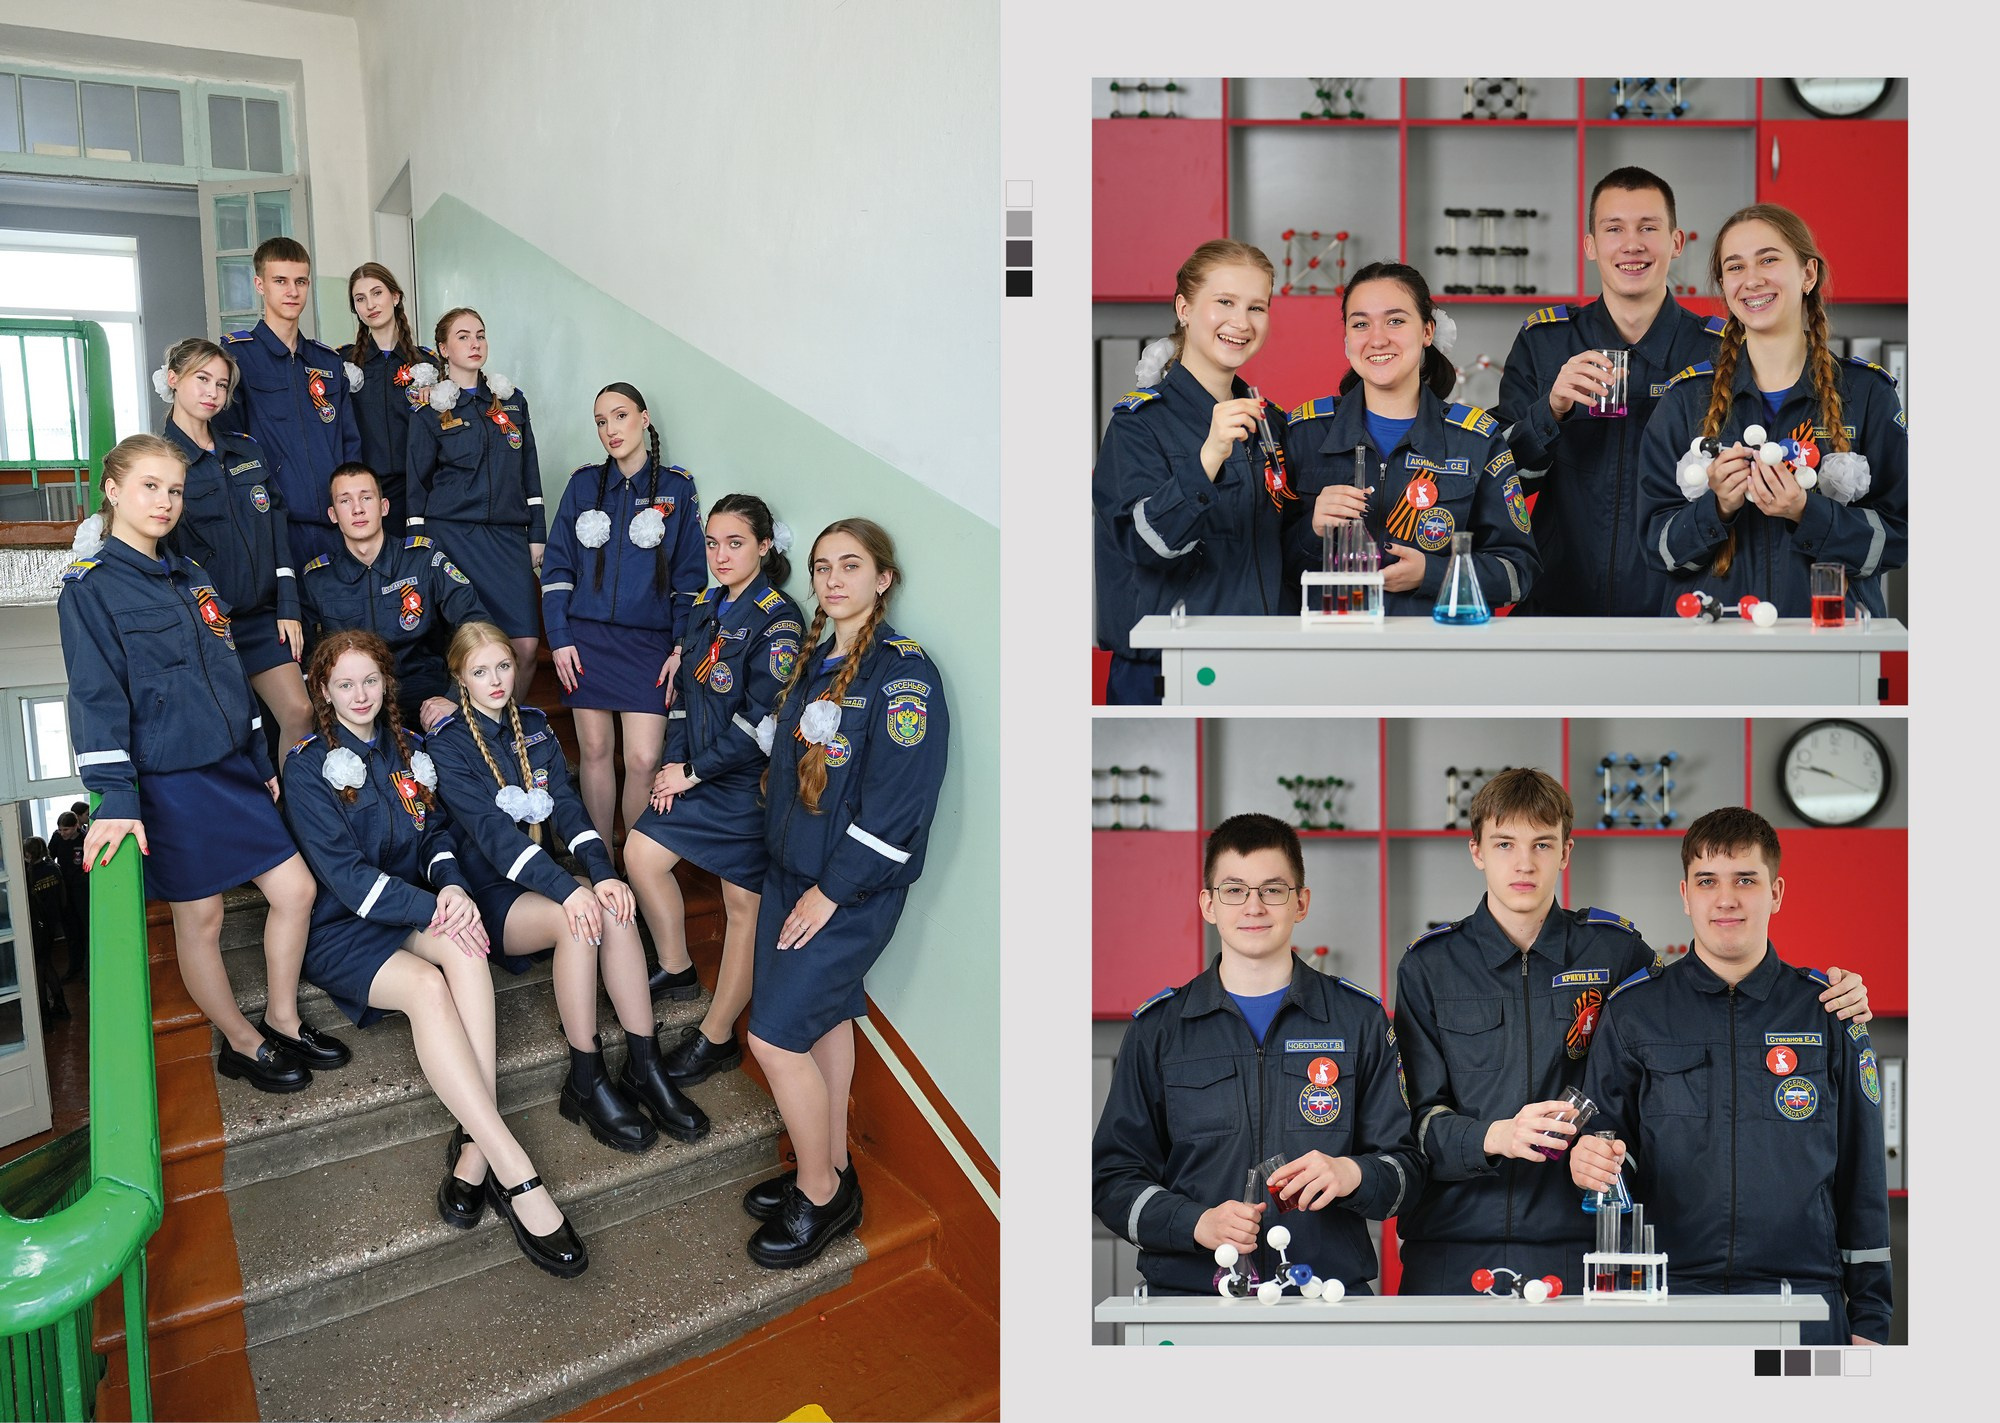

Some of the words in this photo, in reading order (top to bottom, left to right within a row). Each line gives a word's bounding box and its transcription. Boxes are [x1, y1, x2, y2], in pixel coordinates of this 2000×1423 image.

[1421, 509, 1453, 527] АРСЕНЬЕВ
[888, 681, 927, 694] АРСЕНЬЕВ
[1781, 1079, 1813, 1092] АРСЕНЬЕВ
[1304, 1109, 1338, 1123] СПАСАТЕЛЬ
